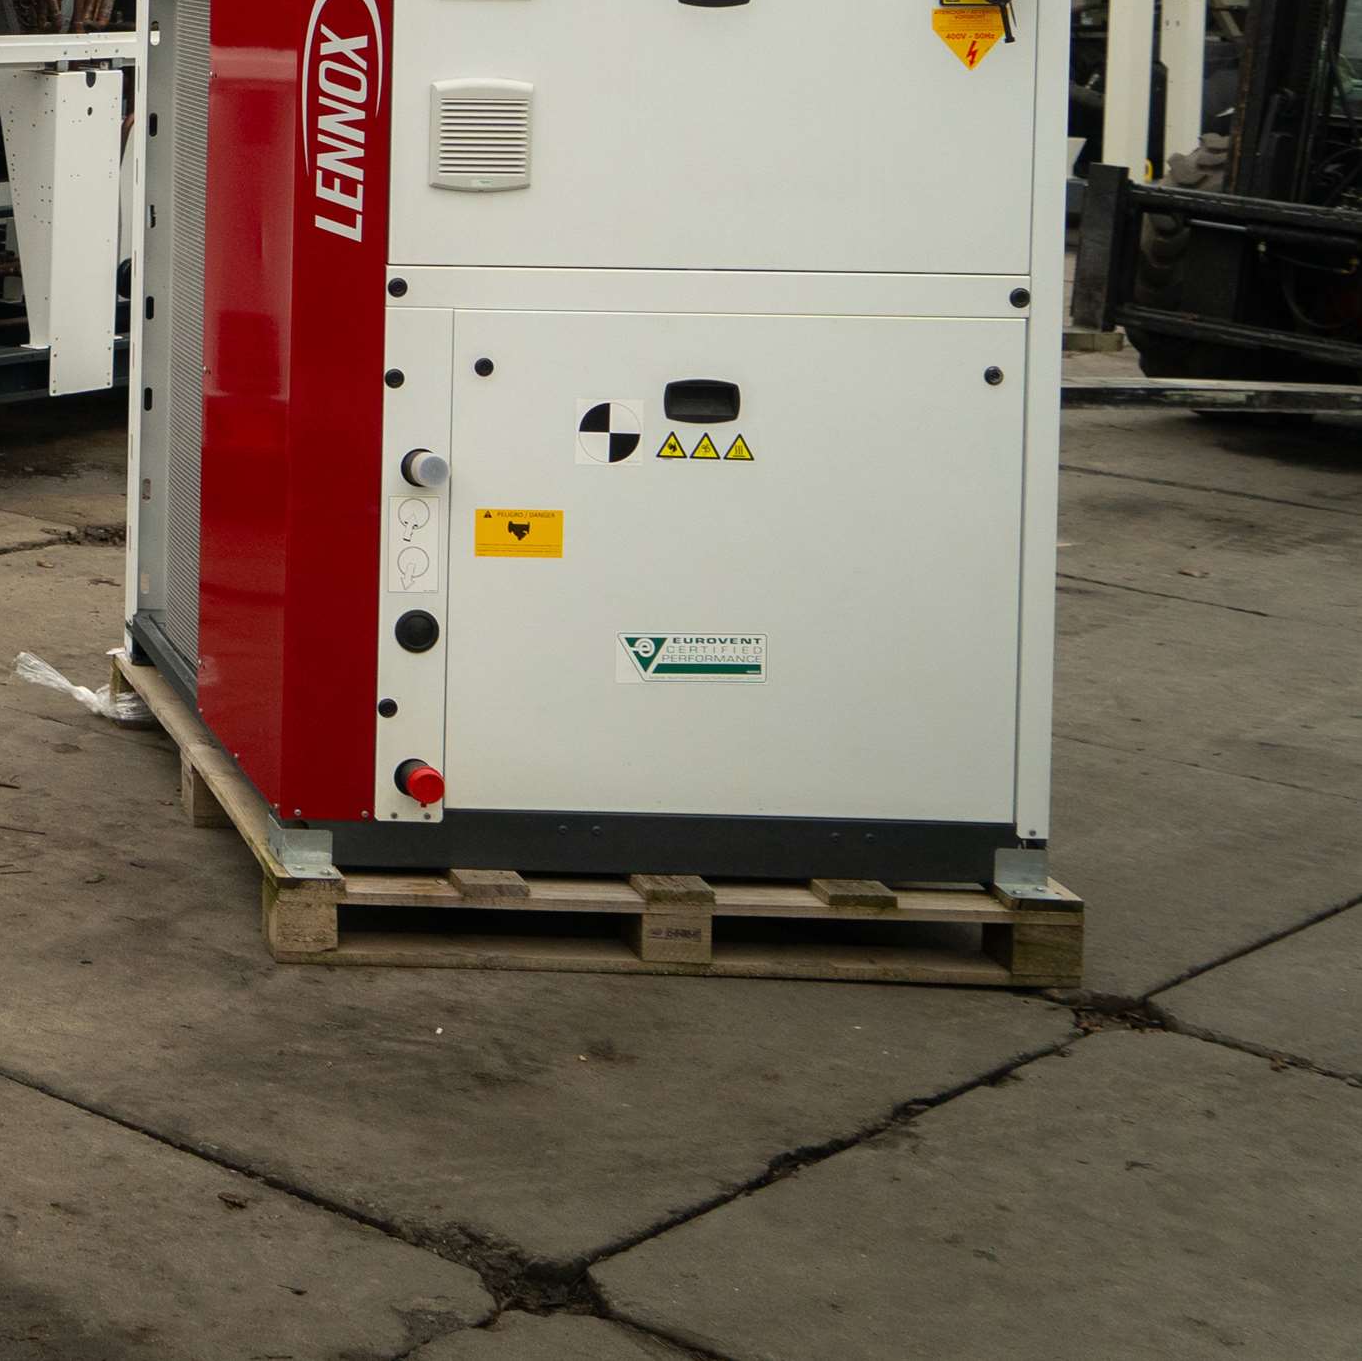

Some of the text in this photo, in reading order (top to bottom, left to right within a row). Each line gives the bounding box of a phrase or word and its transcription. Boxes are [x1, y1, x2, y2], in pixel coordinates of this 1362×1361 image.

[314, 23, 369, 243] LENNOX
[673, 637, 761, 645] EUROVENT
[666, 645, 763, 654] CERTIFIED
[661, 654, 762, 663] PERFORMANCE
